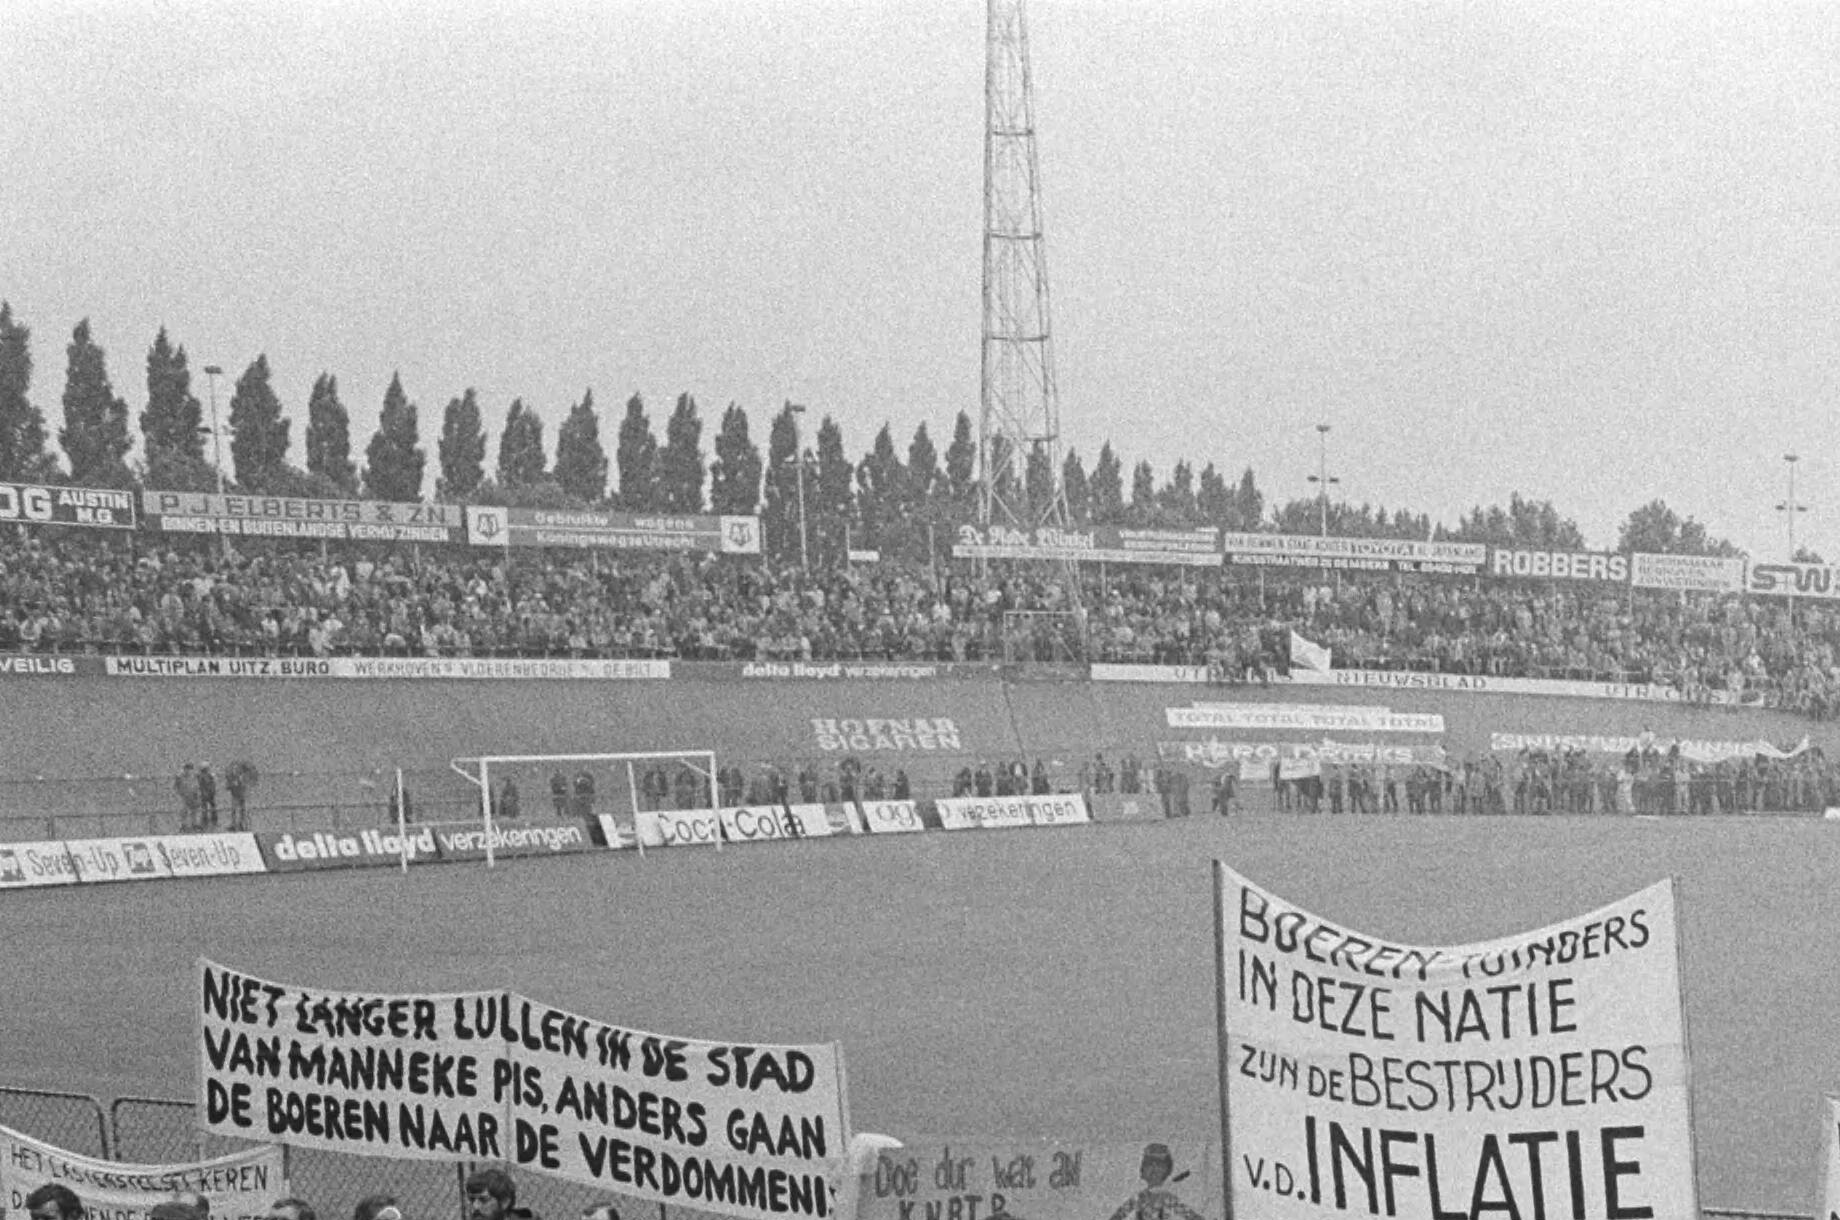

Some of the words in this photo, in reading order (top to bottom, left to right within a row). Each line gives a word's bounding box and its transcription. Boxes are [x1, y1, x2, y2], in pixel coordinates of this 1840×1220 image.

[58, 490, 129, 509] AUSTIN
[225, 496, 361, 521] ELBERTS
[376, 504, 395, 521] &
[1351, 541, 1415, 557] TOYOTA
[1493, 549, 1628, 580] ROBBERS
[117, 658, 220, 674] MULTIPLAN
[743, 662, 790, 677] delta
[793, 662, 841, 679] lloyd
[1336, 670, 1488, 689] NIEUWSBLAD
[817, 734, 962, 750] SIGAREN
[274, 831, 360, 860] delta
[360, 827, 437, 860] lloyd
[440, 825, 583, 851] verzekeringen
[1238, 948, 1277, 1011] IN
[1292, 970, 1395, 1041] DEZE
[1415, 978, 1578, 1042] NATIE
[203, 966, 286, 1028] NIET
[296, 992, 438, 1041] LANGER
[453, 992, 590, 1060] LULLEN
[596, 1025, 632, 1072] IN
[641, 1037, 689, 1082] DE
[706, 1046, 814, 1094] STAD
[203, 1024, 282, 1078] VAN
[287, 1035, 478, 1099] MANNEKE
[555, 1075, 708, 1147] ANDERS
[726, 1107, 827, 1160] GAAN
[1239, 1043, 1298, 1090] ZIJN
[1308, 1066, 1345, 1101] DE
[1349, 1045, 1653, 1112] BESTRIJDERS
[206, 1077, 253, 1128] DE
[265, 1086, 390, 1144] BOEREN
[399, 1101, 500, 1157] NAAR
[515, 1117, 561, 1169] DE
[10, 1142, 43, 1173] HET
[200, 1164, 268, 1193] KEREN
[875, 1154, 919, 1198] Doe
